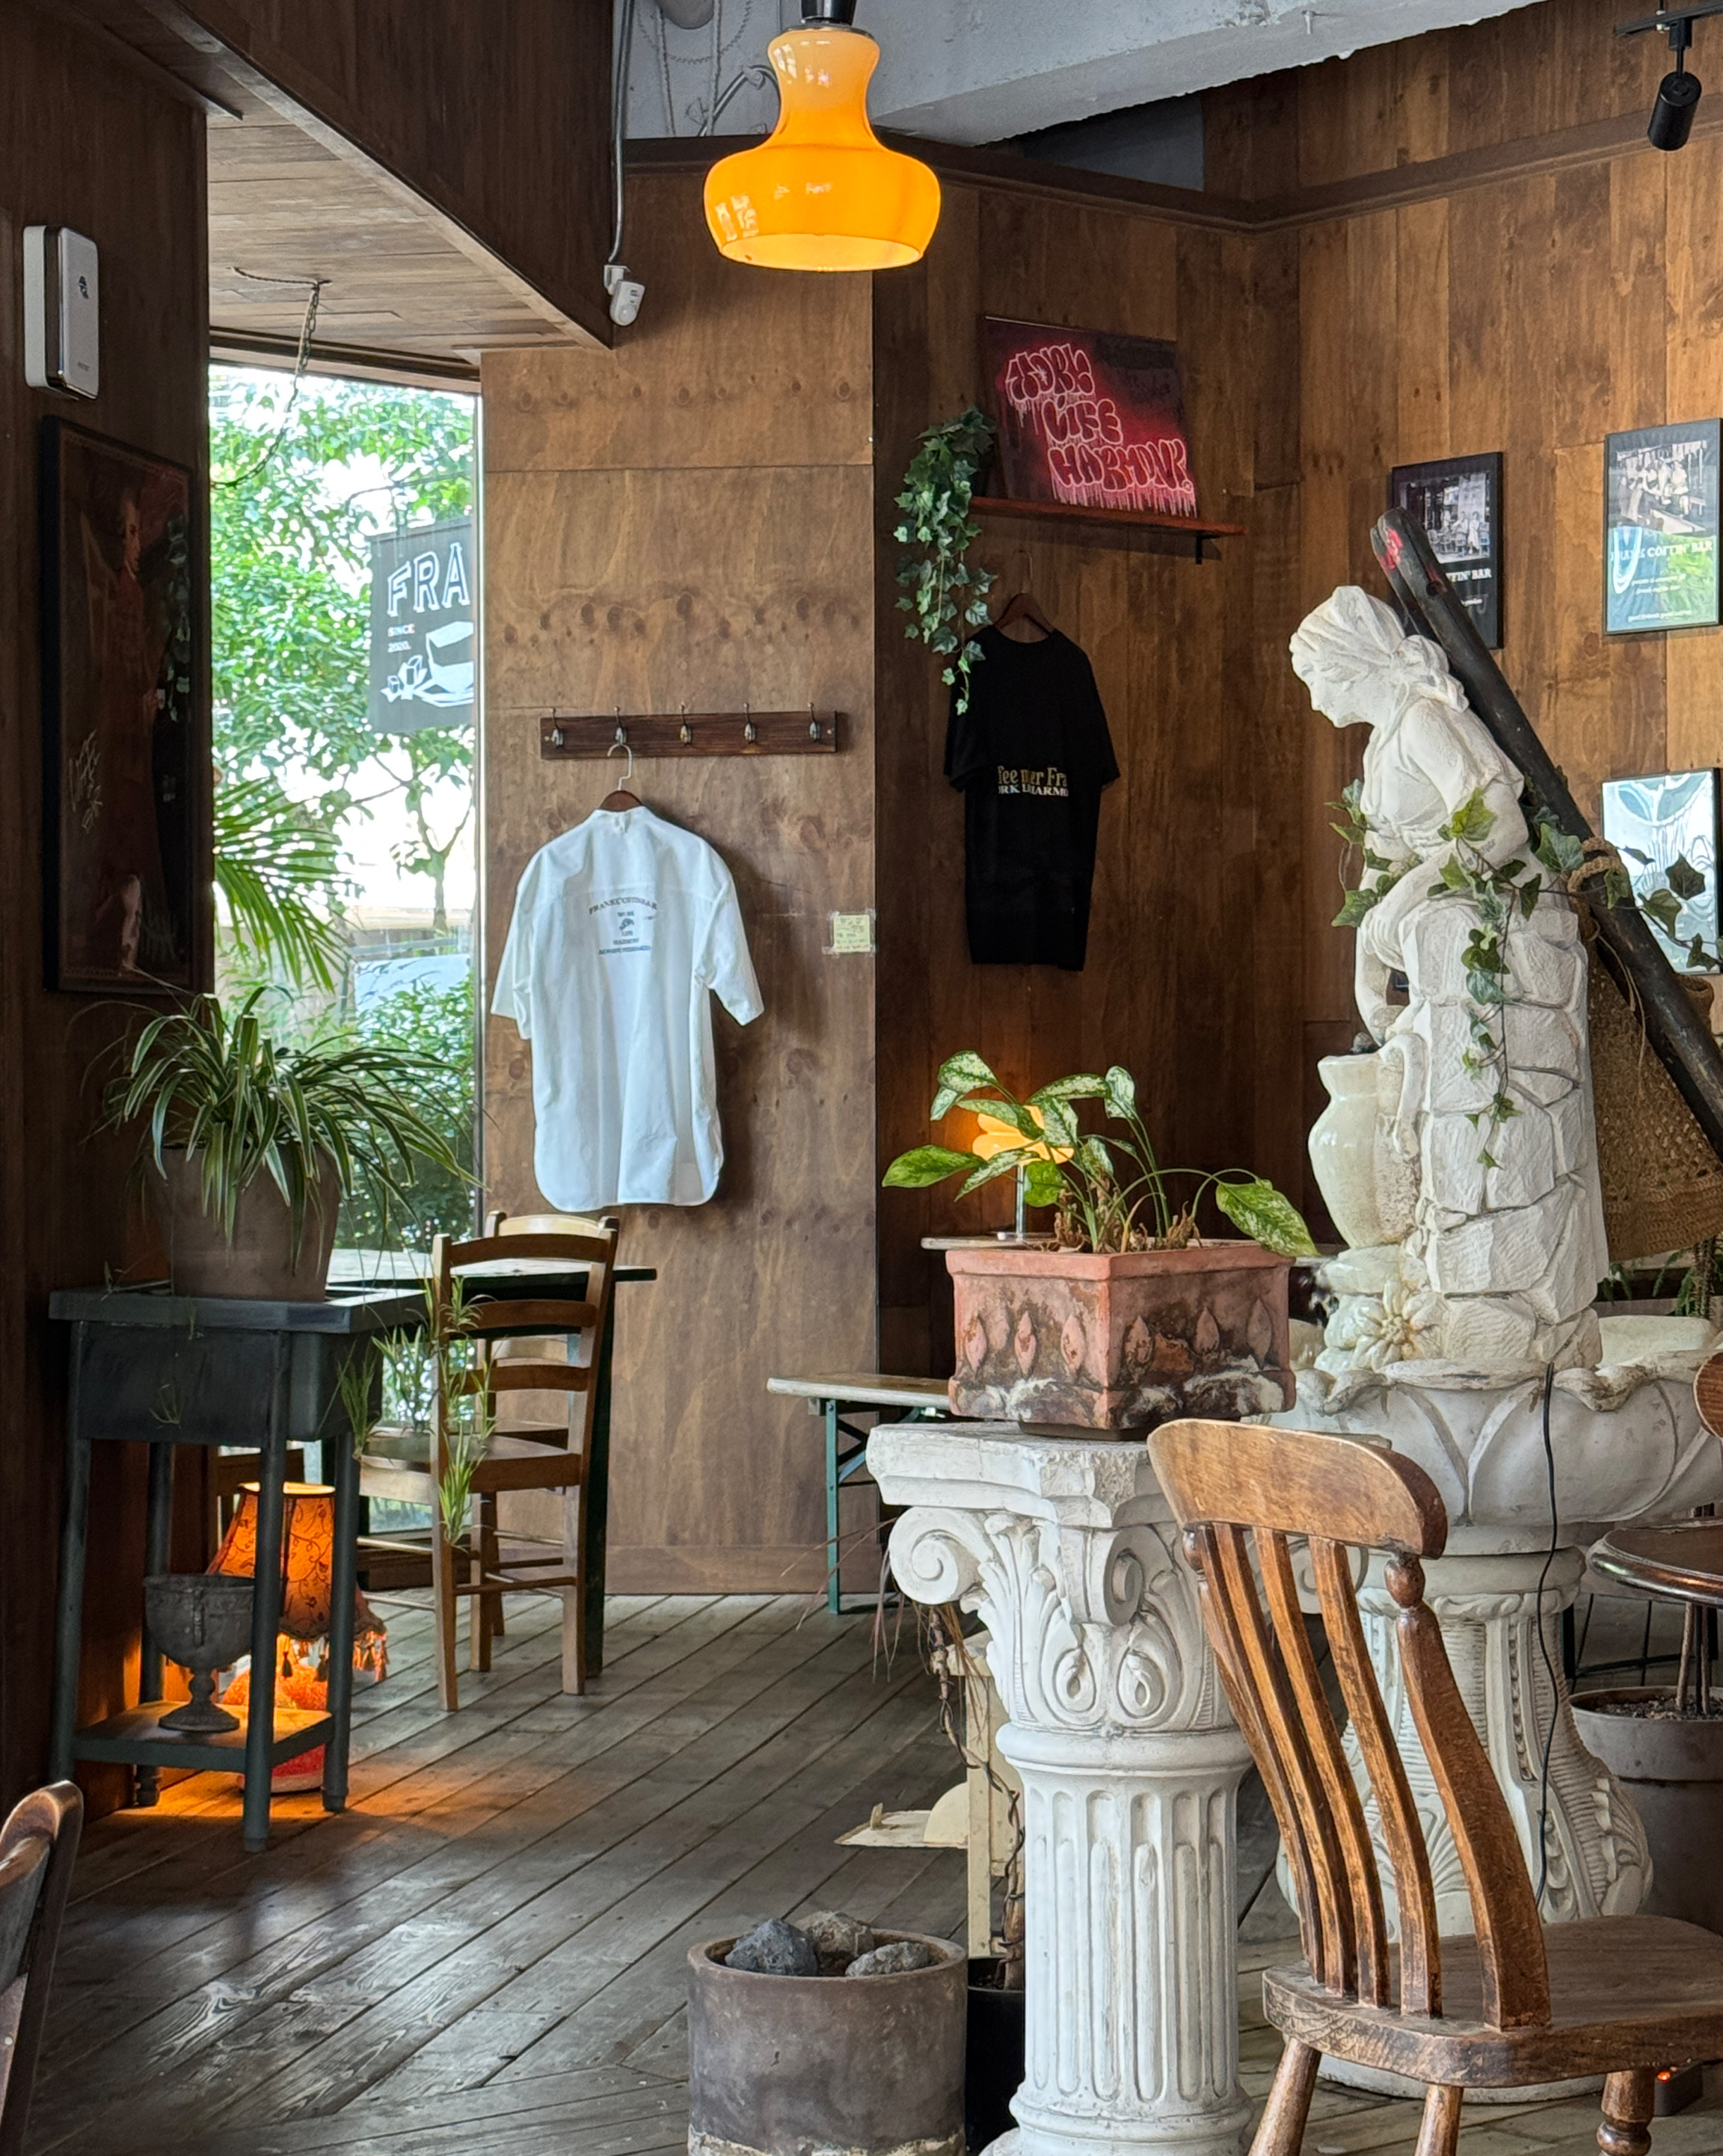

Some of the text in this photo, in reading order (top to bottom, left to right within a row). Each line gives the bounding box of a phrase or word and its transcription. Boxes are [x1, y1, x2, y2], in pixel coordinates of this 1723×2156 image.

[1041, 394, 1123, 444] LIFE
[387, 541, 470, 618] FRA
[1472, 568, 1492, 580] BAR
[387, 623, 415, 637] SINCE
